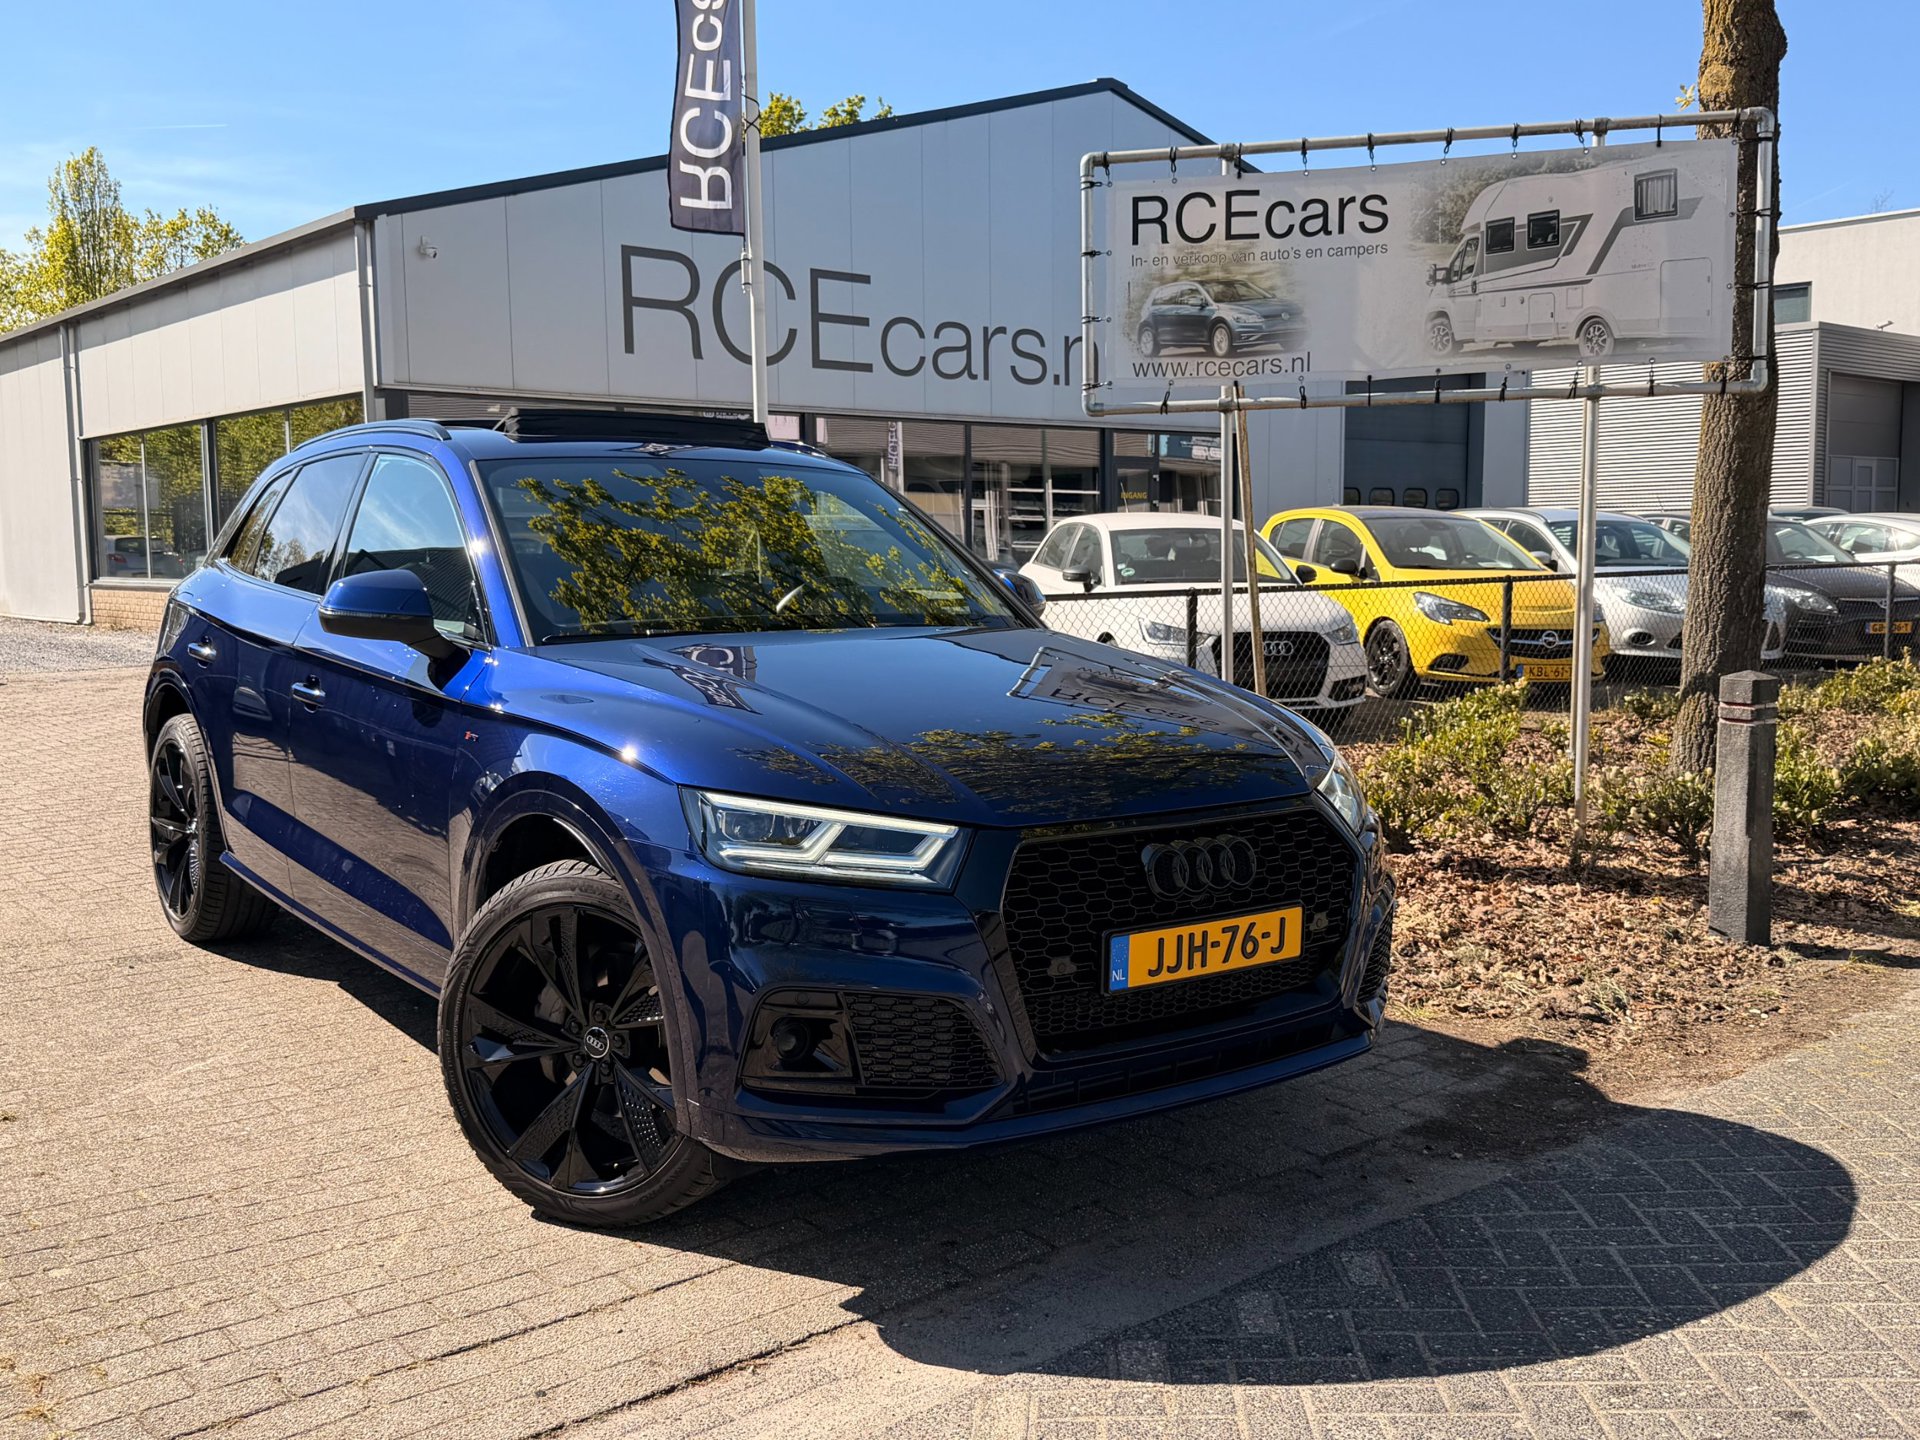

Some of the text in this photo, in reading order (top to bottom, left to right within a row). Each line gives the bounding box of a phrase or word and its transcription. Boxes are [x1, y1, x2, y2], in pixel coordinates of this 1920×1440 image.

[1131, 189, 1390, 246] RCEcars
[1131, 242, 1389, 267] In- en verkoop van auto's en campers
[1132, 351, 1311, 378] www.rcecars.nl
[1120, 491, 1148, 500] INGANG
[1111, 916, 1286, 982] NL JJH-76-J
